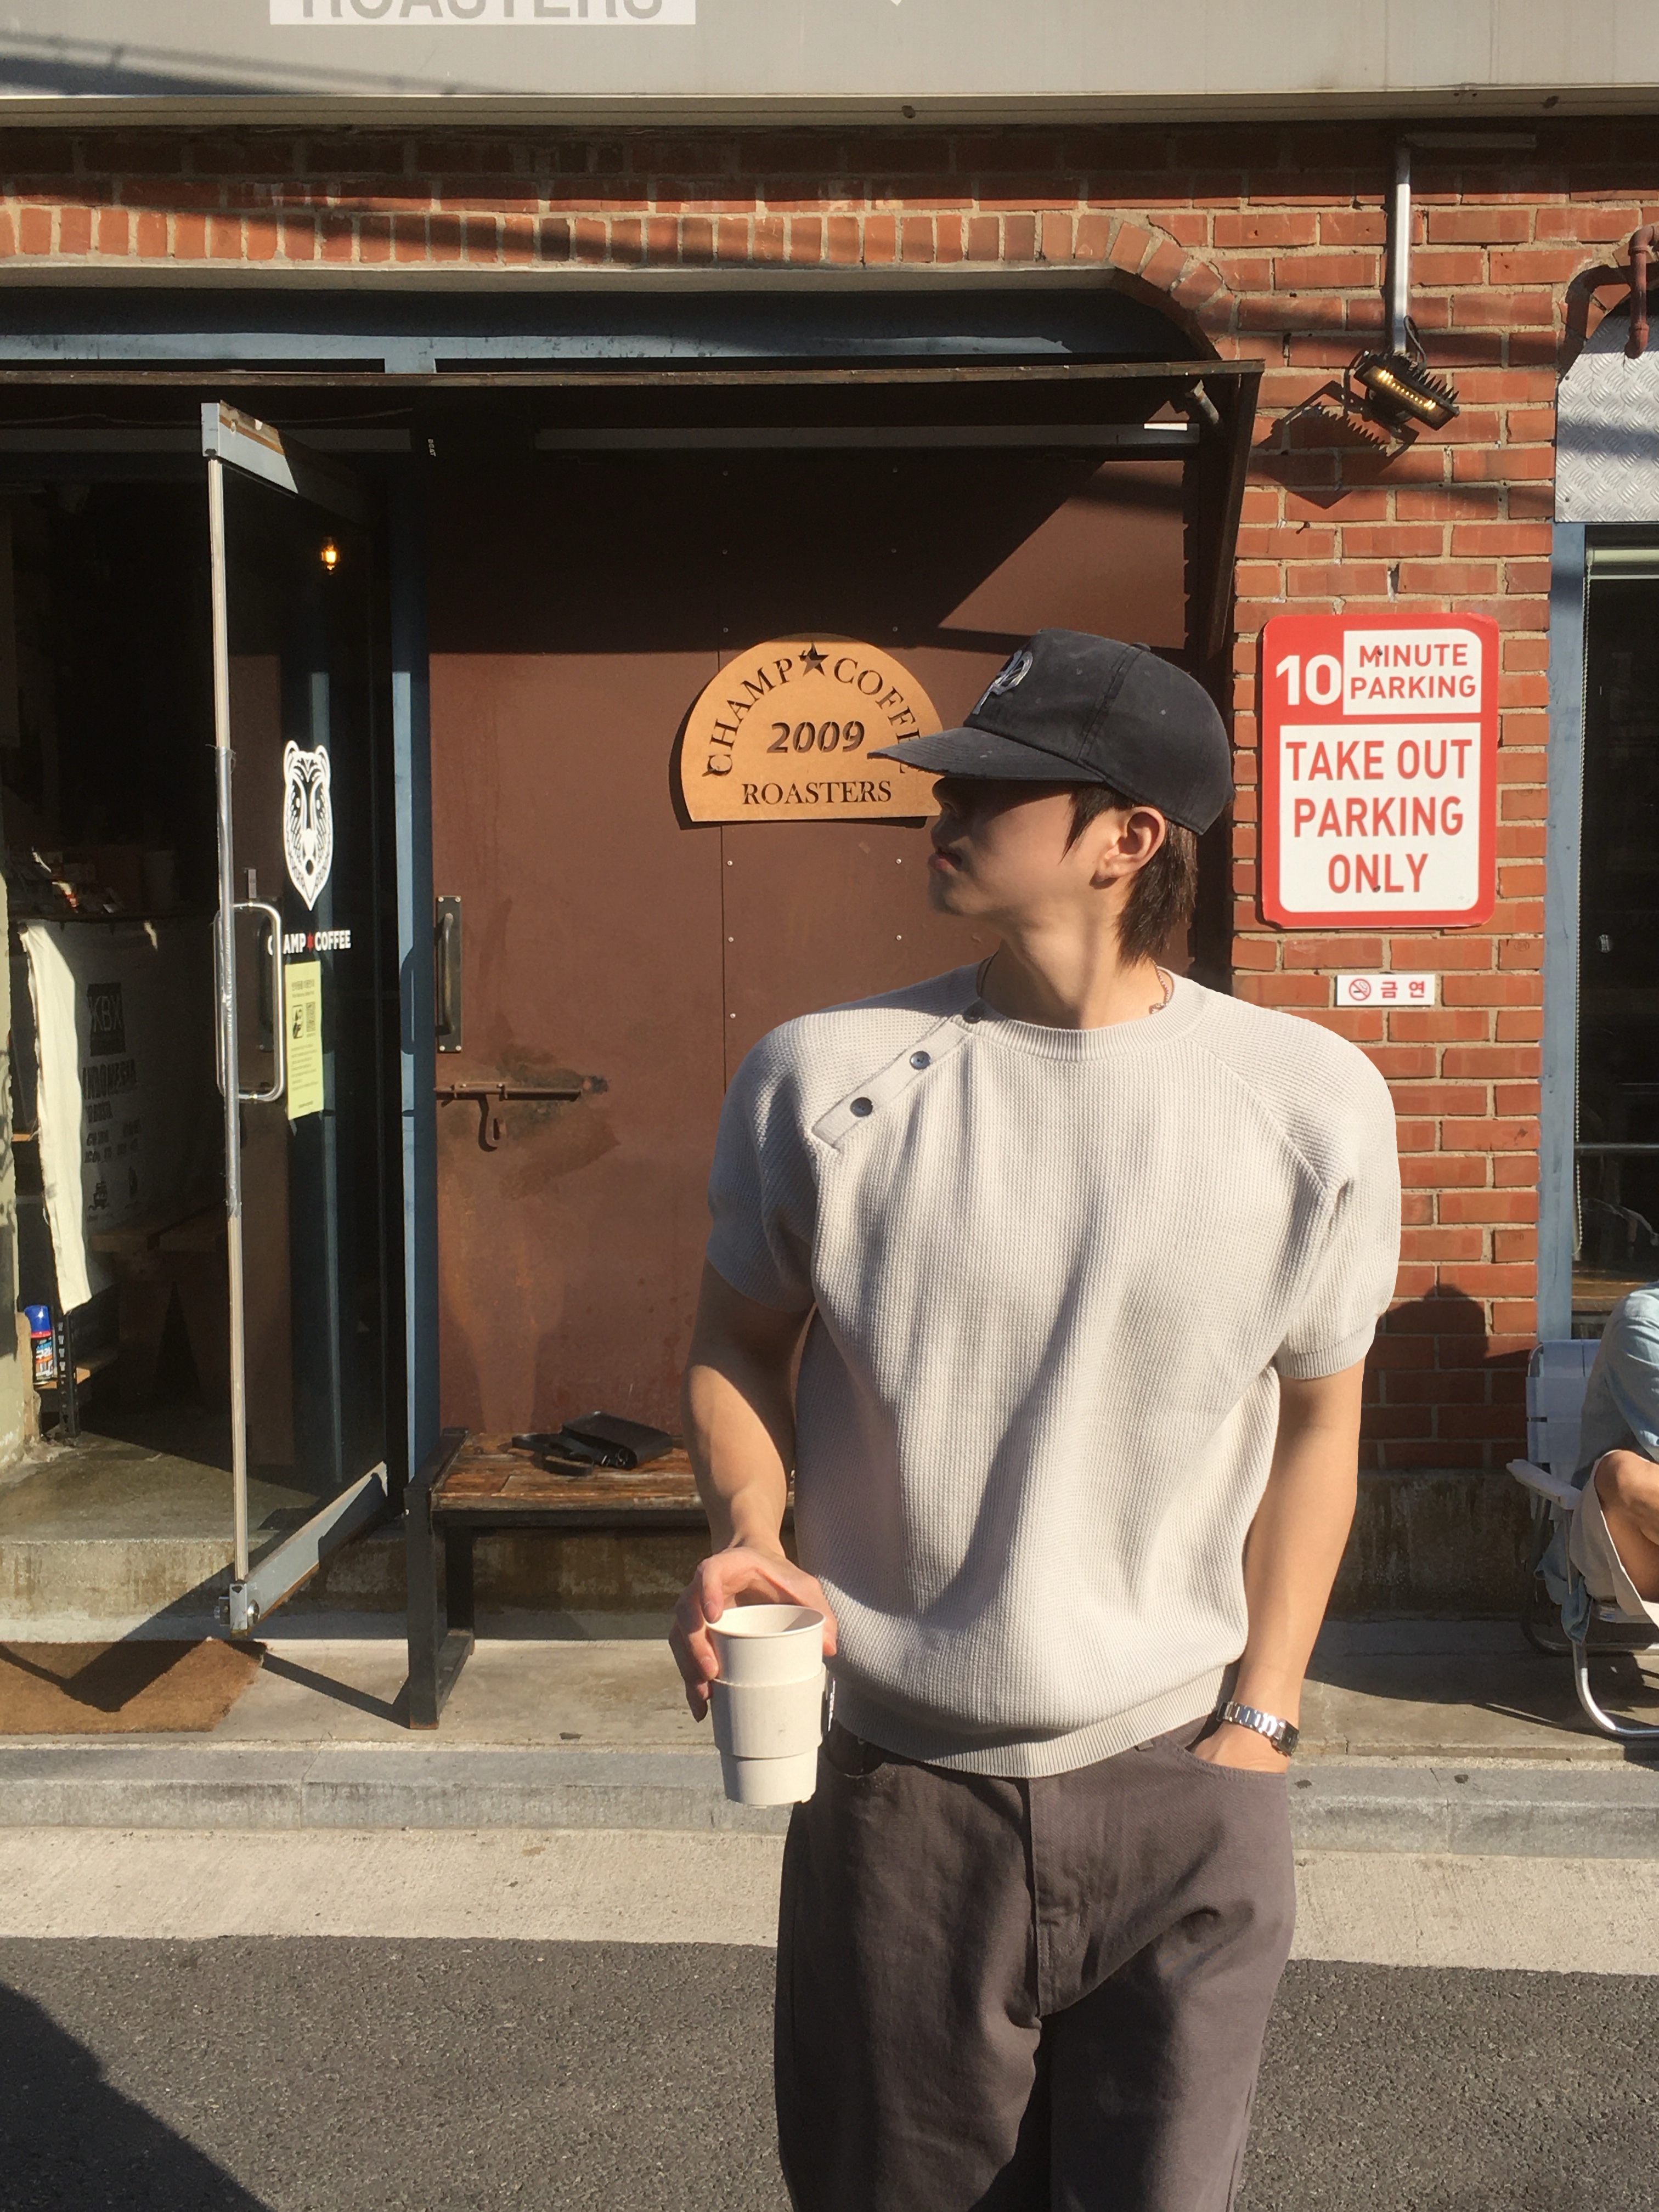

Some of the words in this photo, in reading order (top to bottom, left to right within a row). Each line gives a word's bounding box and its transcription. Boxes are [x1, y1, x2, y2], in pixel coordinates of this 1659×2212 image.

[1359, 643, 1469, 667] MINUTE
[1275, 654, 1342, 705] 10
[1351, 675, 1476, 700] PARKING
[702, 658, 793, 778] CHAMP
[766, 720, 865, 754] 2009
[1285, 740, 1384, 782] TAKE
[1397, 739, 1472, 779] OUT
[741, 780, 892, 805] ROASTERS
[1294, 796, 1464, 838] PARKING
[1328, 853, 1429, 894] ONLY
[267, 932, 306, 956] CAMP
[314, 930, 351, 952] COFFEE
